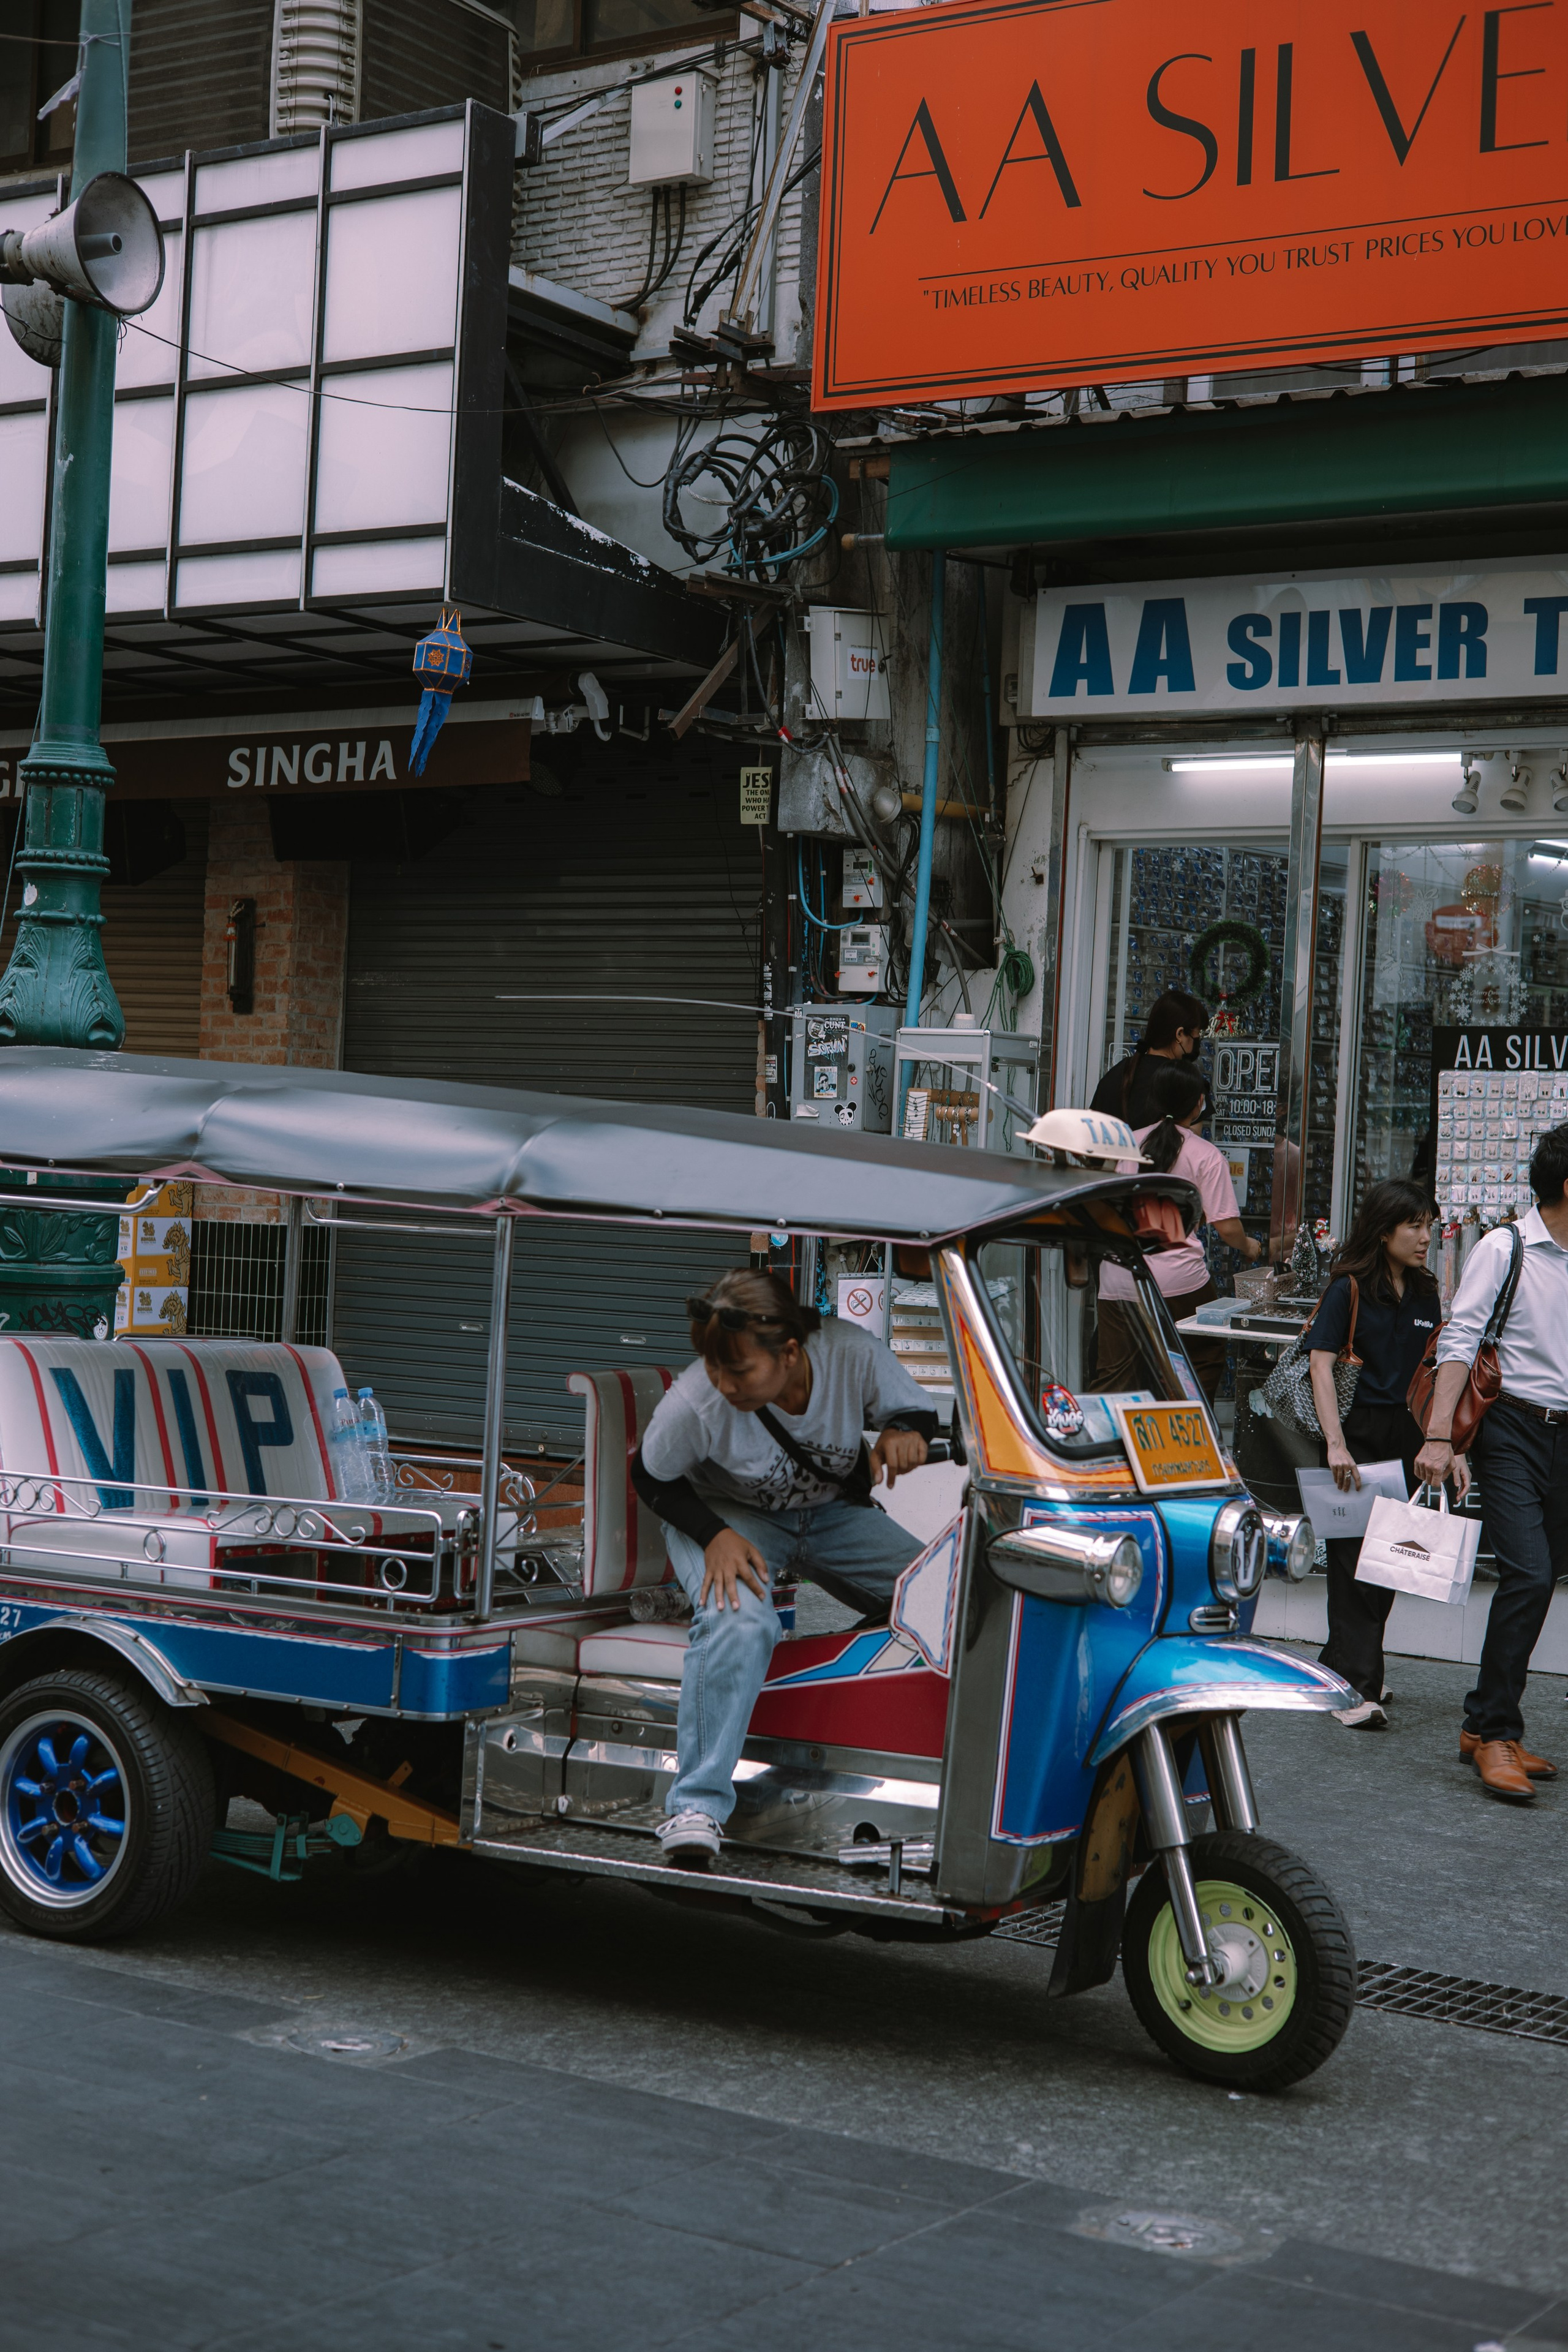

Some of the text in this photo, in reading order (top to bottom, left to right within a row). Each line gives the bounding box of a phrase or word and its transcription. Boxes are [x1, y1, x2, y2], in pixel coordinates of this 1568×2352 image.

[869, 1, 1568, 235] AA SILVE
[1028, 269, 1116, 300] BEAUTY,
[1120, 257, 1218, 292] QUALITY
[1226, 250, 1276, 277] YOU
[1283, 241, 1355, 270] TRUST
[1365, 230, 1444, 260] PRICES
[1452, 222, 1507, 251] YOU
[1513, 213, 1568, 243] LOV
[850, 654, 876, 673] true
[1048, 597, 1196, 698] AA
[1226, 601, 1488, 691] SILVER
[227, 740, 397, 788] SINGHA
[1216, 1048, 1280, 1091] OPE
[1453, 1035, 1493, 1069] AA
[1215, 1108, 1226, 1117] SAT
[1223, 1125, 1251, 1136] CLOSED
[1080, 1118, 1136, 1148] TAXI
[48, 1367, 295, 1509] VIP
[1168, 1412, 1208, 1448] 4527
[1389, 1545, 1431, 1562] CHÂTERAISÉ
